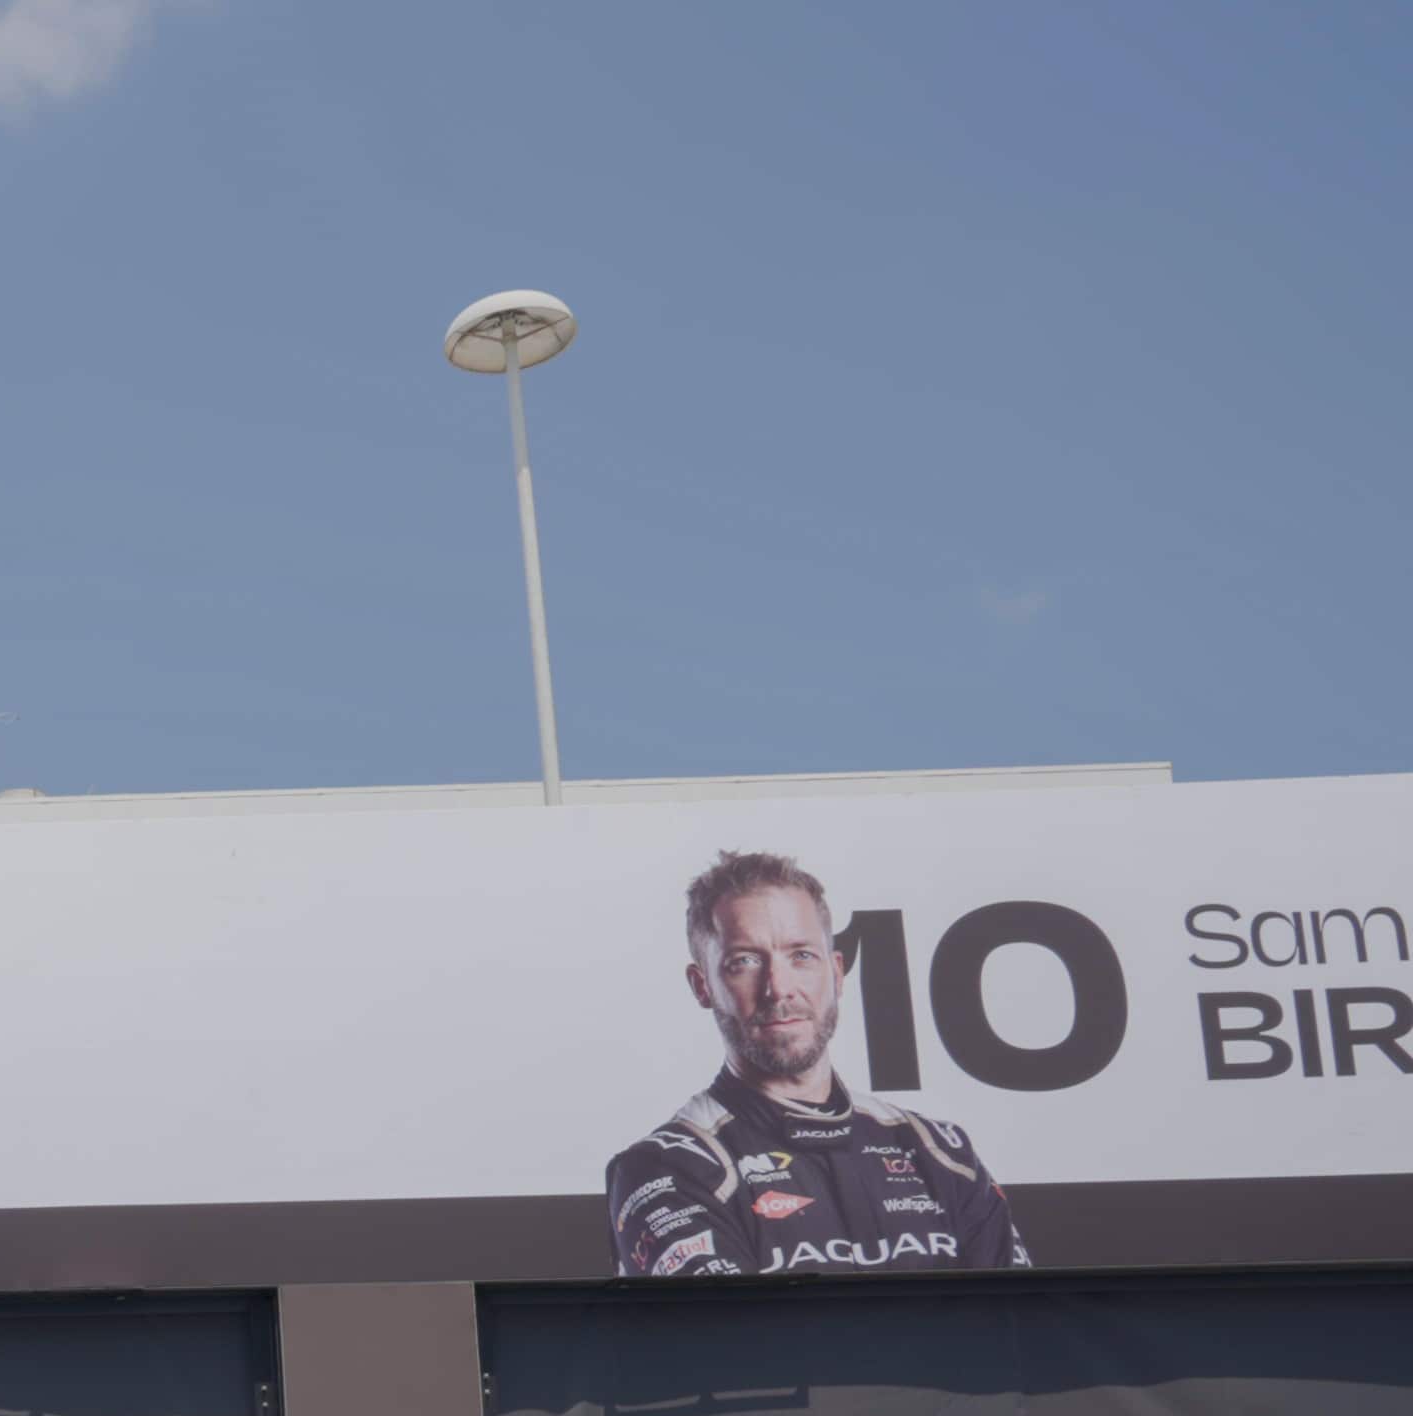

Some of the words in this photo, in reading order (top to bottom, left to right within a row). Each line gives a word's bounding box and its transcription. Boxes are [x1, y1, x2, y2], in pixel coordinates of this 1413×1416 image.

[1184, 904, 1410, 969] Sam
[830, 900, 1128, 1092] 10
[758, 1232, 958, 1275] JAGUAR
